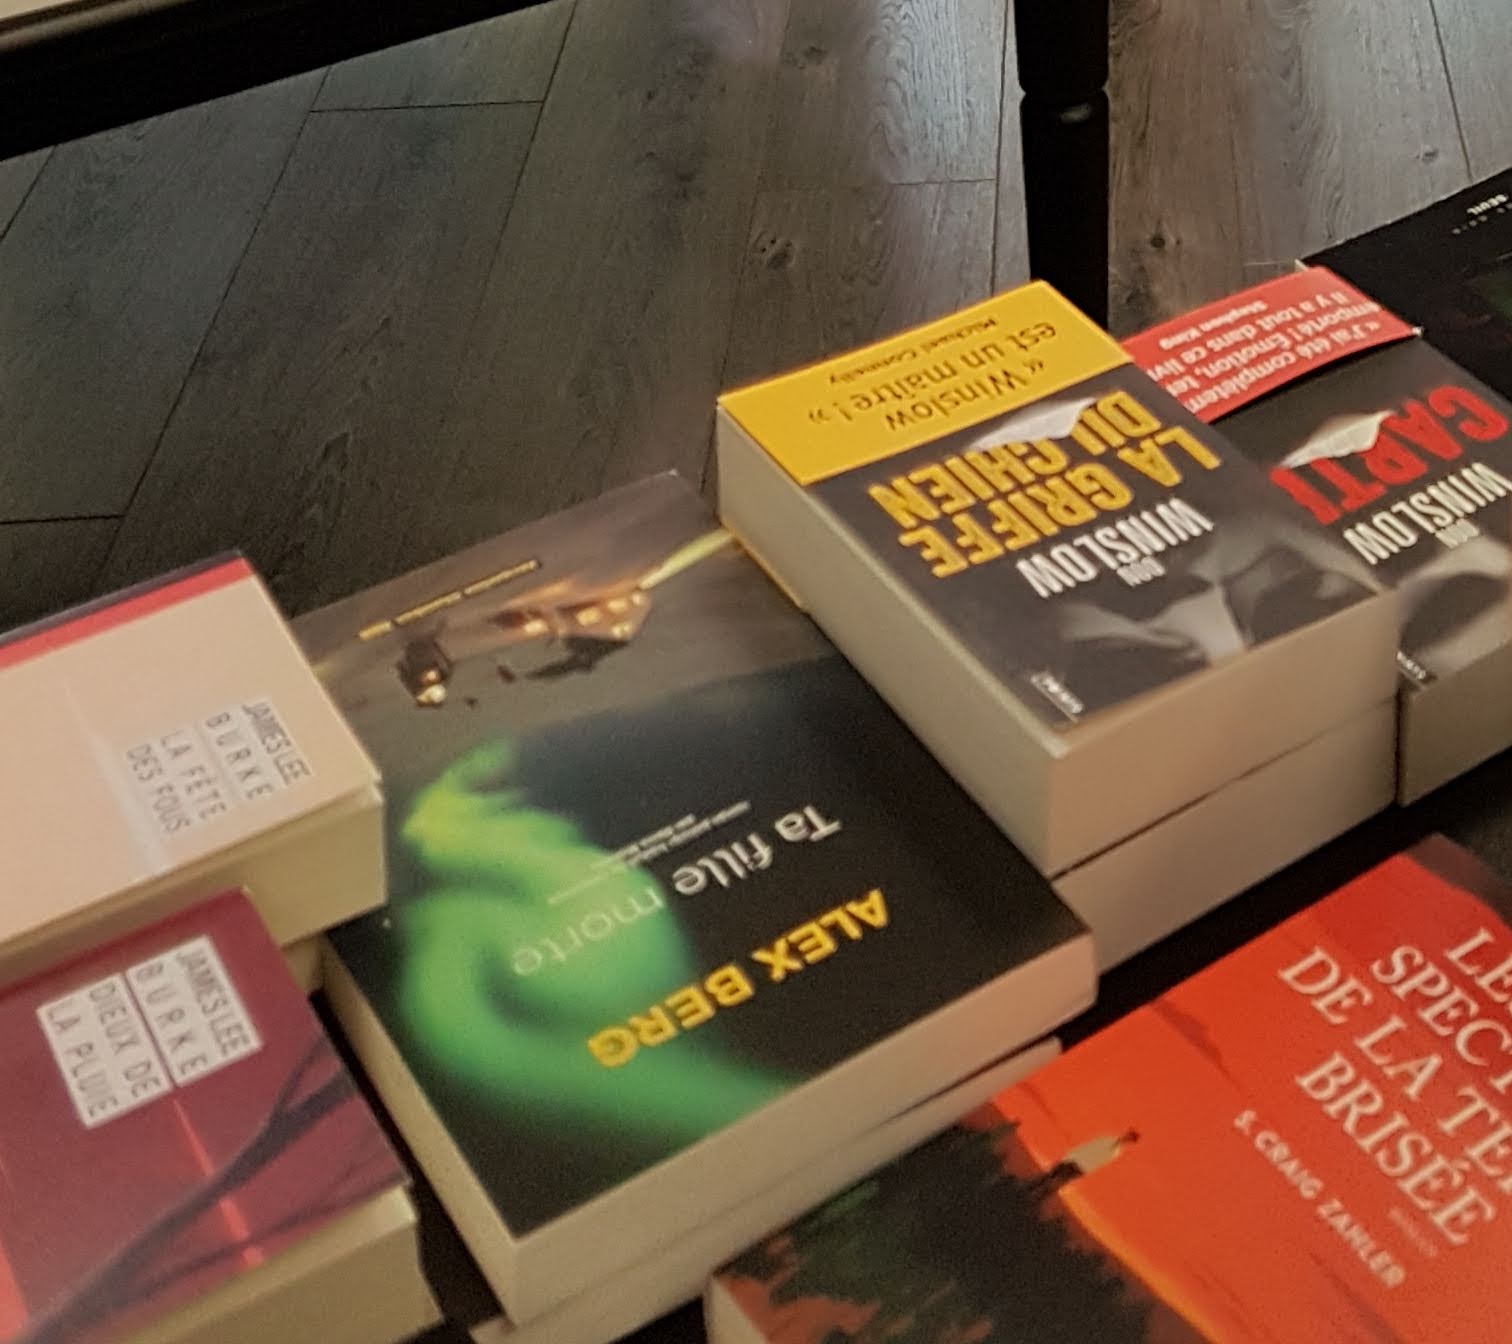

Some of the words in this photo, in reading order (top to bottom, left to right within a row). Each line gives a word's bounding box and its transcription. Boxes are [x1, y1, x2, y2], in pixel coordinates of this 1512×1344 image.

[960, 340, 1006, 369] un
[1010, 321, 1057, 351] est
[1181, 346, 1207, 363] ce
[1206, 325, 1257, 351] dans
[1259, 305, 1300, 330] tout
[850, 356, 958, 410] maître
[886, 368, 1029, 431] Winslow
[867, 436, 1070, 530] CHIEN
[1117, 425, 1221, 488] LA
[898, 461, 1134, 579] GRIFFE
[1015, 496, 1215, 599] WINSLOW
[159, 728, 190, 765] LA
[204, 711, 275, 802] BURKE
[242, 697, 284, 757] JAMES
[126, 743, 161, 786] DES
[147, 780, 193, 838] FOUS
[773, 804, 845, 846] Ta
[673, 831, 783, 896] fille
[512, 884, 663, 978] morte
[753, 888, 892, 982] ALEX
[87, 981, 142, 1056] DIEUX
[128, 1058, 162, 1100] DE
[133, 963, 210, 1078] BURKE
[176, 948, 225, 1022] JAMES
[212, 1012, 252, 1056] LEE
[587, 961, 757, 1070] BERG
[1277, 946, 1375, 1031] DE
[1355, 1018, 1447, 1102] LA
[46, 1006, 76, 1050] LA
[70, 1048, 121, 1119] PLUIE
[1294, 1051, 1500, 1248] BRISÉE
[1251, 1128, 1325, 1203] CRAIG
[1315, 1192, 1407, 1291] ZAHLER
